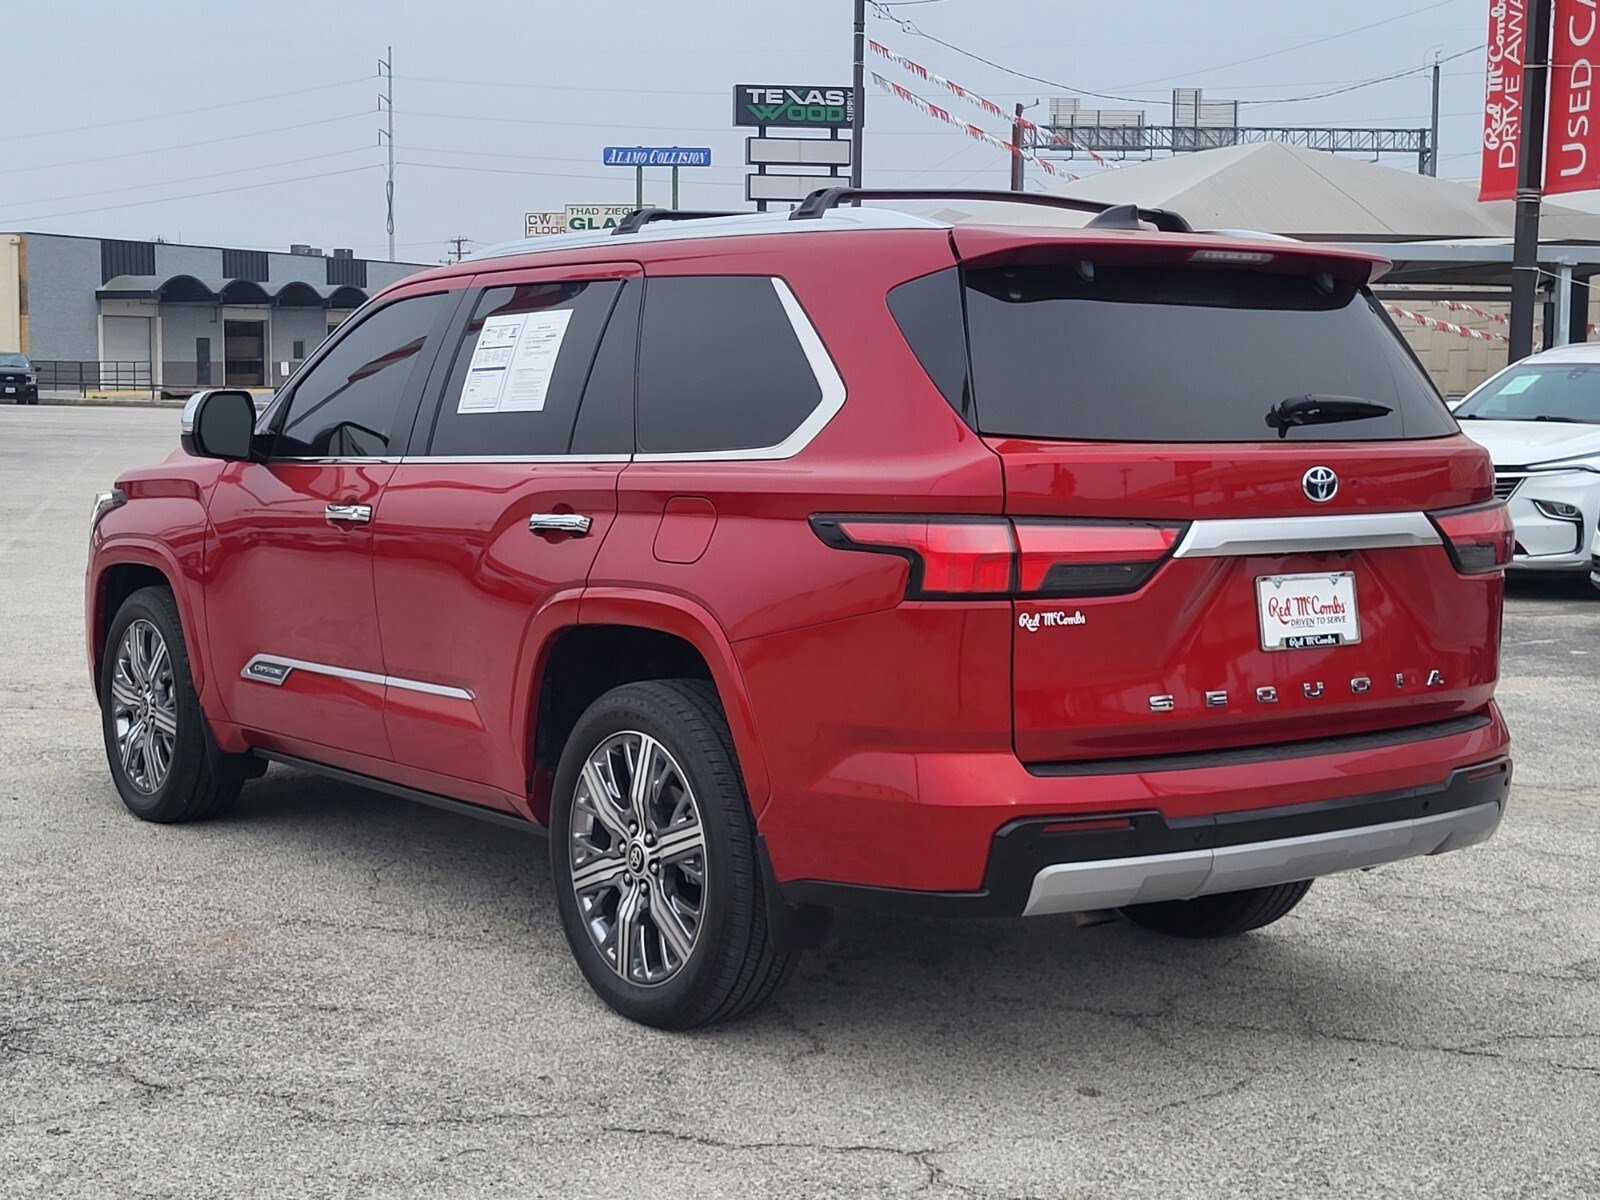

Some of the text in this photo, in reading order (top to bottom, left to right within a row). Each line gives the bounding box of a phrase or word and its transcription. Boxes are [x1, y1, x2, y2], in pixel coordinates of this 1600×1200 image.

[1484, 0, 1507, 151] Red McComb
[745, 88, 846, 106] TEXAS
[1560, 0, 1597, 177] USED C
[746, 98, 845, 122] WOOD
[1498, 74, 1520, 169] DRIVE
[606, 149, 707, 165] ALAMO COLLISION
[528, 215, 552, 225] CW
[569, 207, 600, 216] THAD
[568, 217, 618, 230] GLA
[1018, 610, 1086, 632] Red McCombs
[1268, 595, 1346, 625] Red McCombs
[1290, 615, 1347, 627] DRIVEN TO SERVE
[1149, 669, 1445, 712] SEQUOIA
